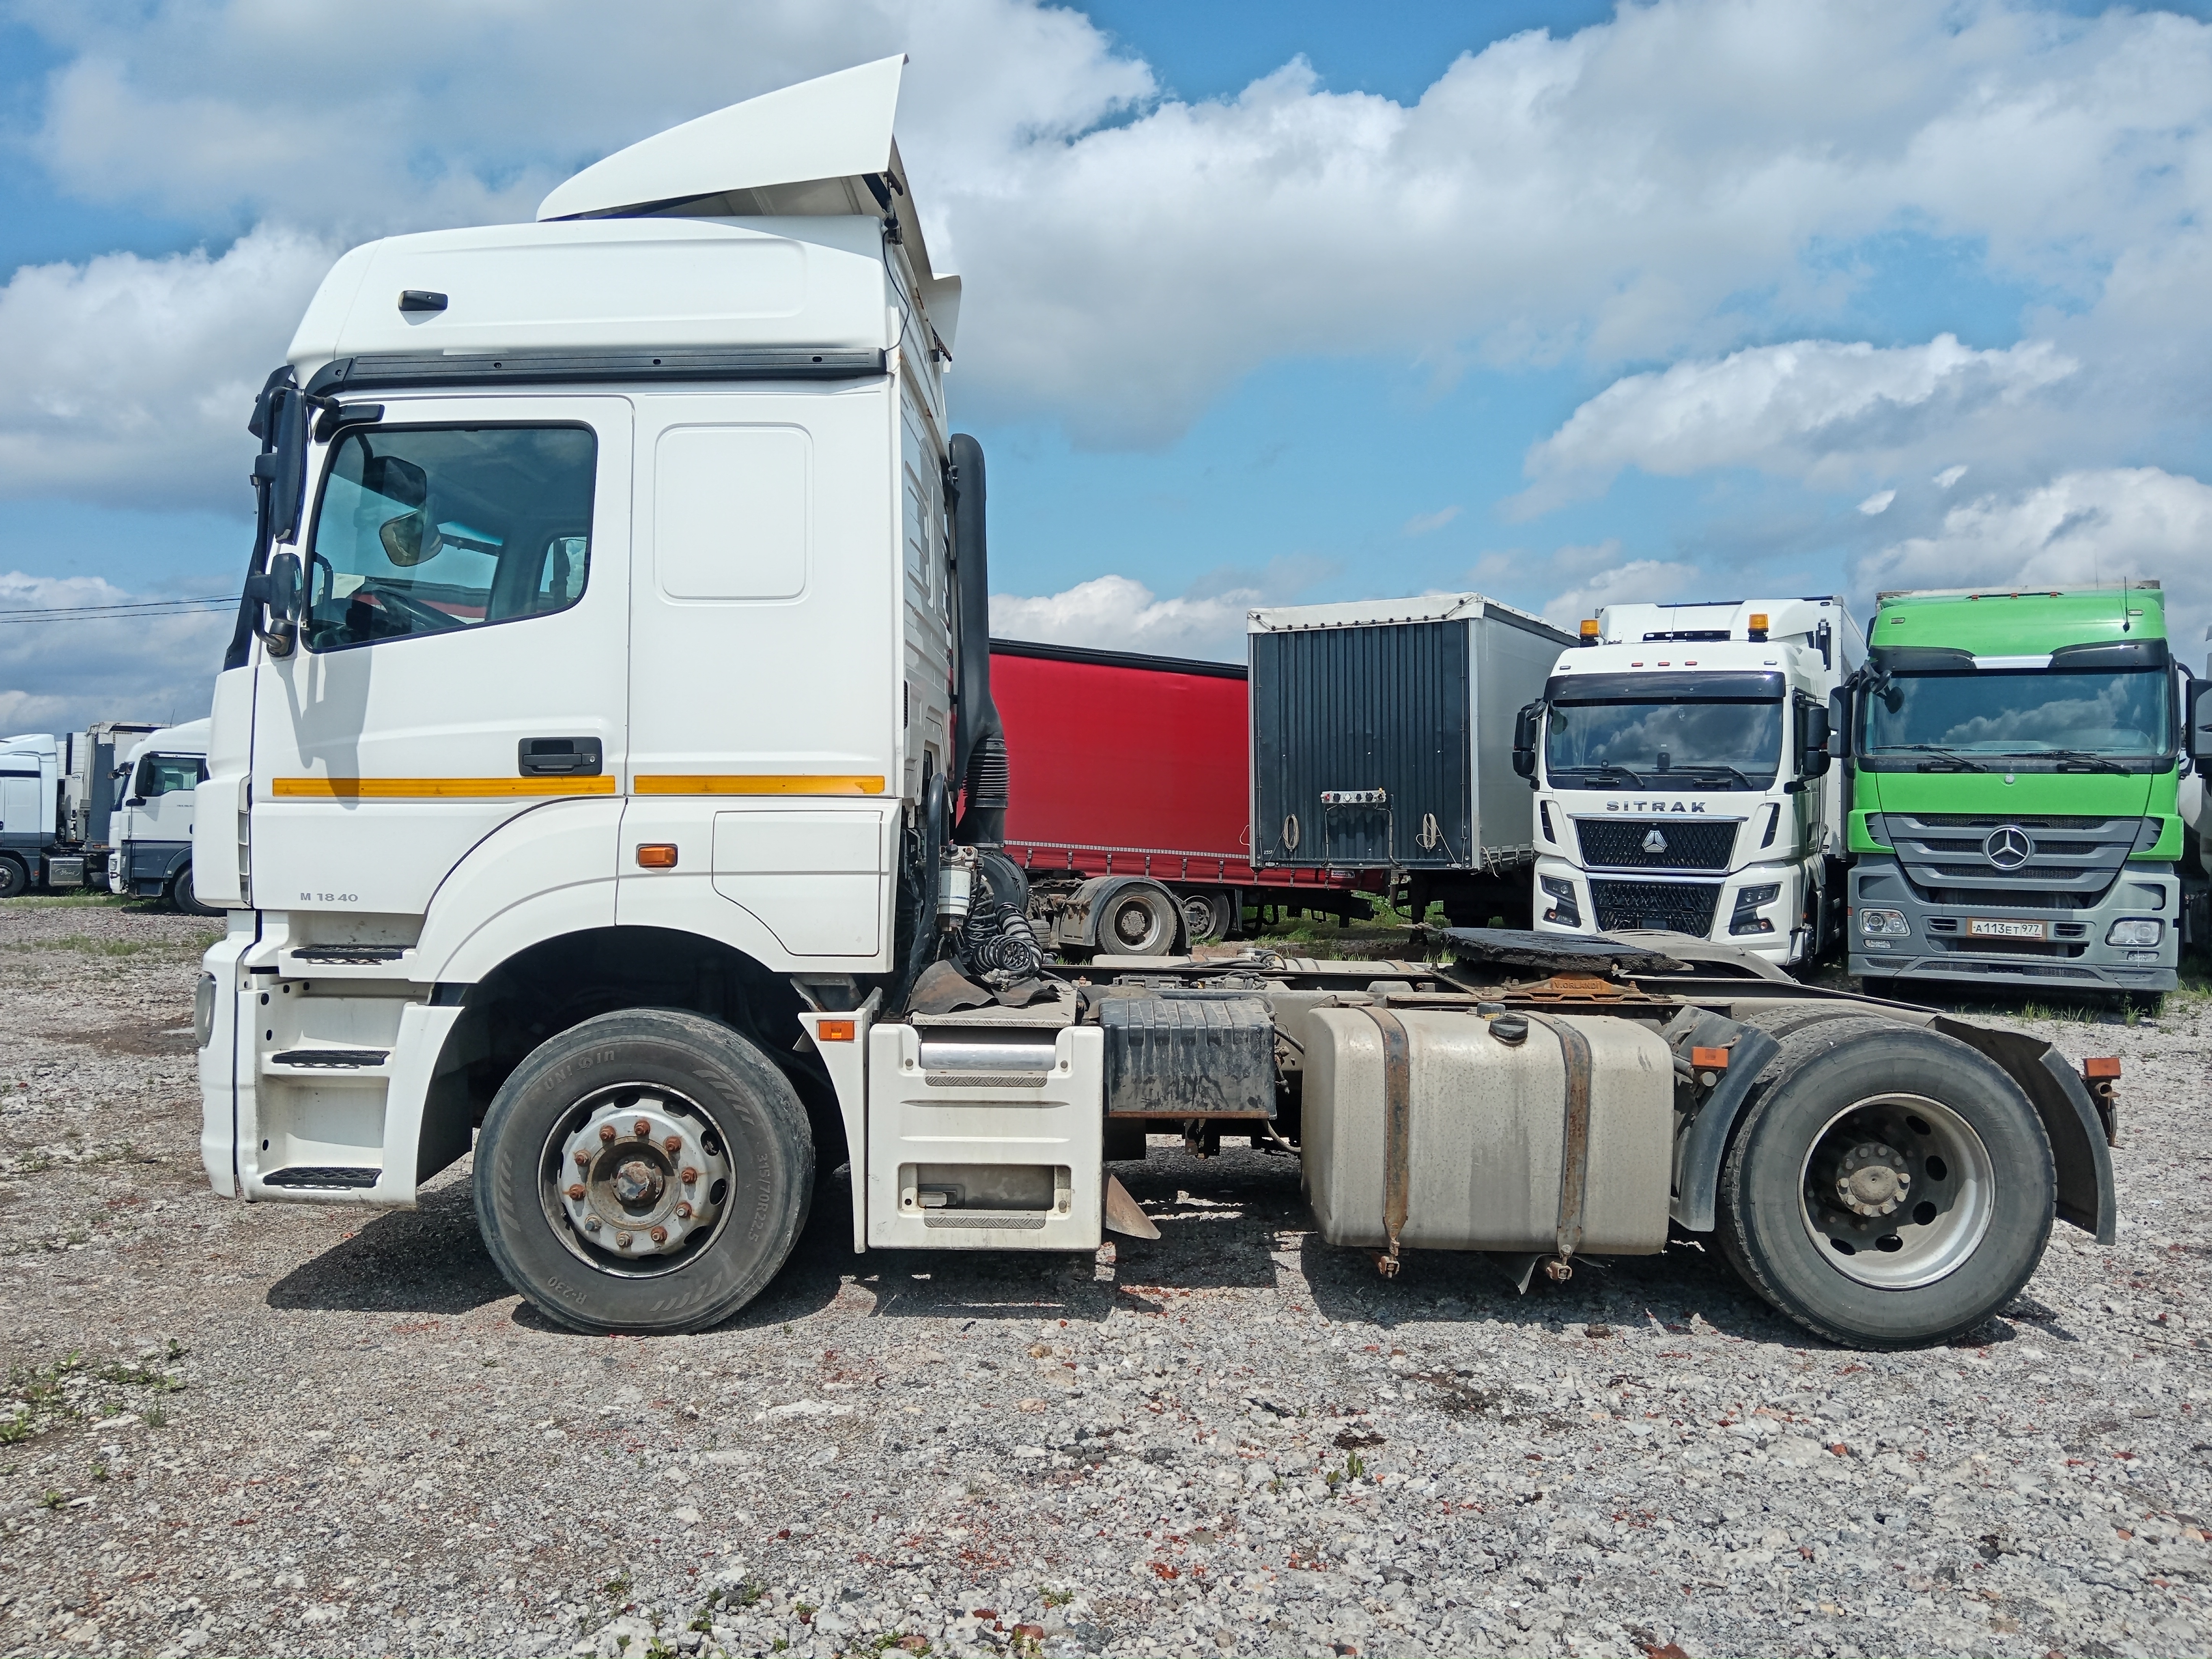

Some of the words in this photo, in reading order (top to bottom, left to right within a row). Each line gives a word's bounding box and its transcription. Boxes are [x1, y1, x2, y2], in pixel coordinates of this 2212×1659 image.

[1606, 800, 1706, 812] SITRAK
[300, 893, 311, 901] M
[317, 893, 358, 902] 1840
[2022, 924, 2039, 932] 977
[748, 1153, 770, 1242] 315/70R22.5
[547, 1276, 587, 1305] R-230
